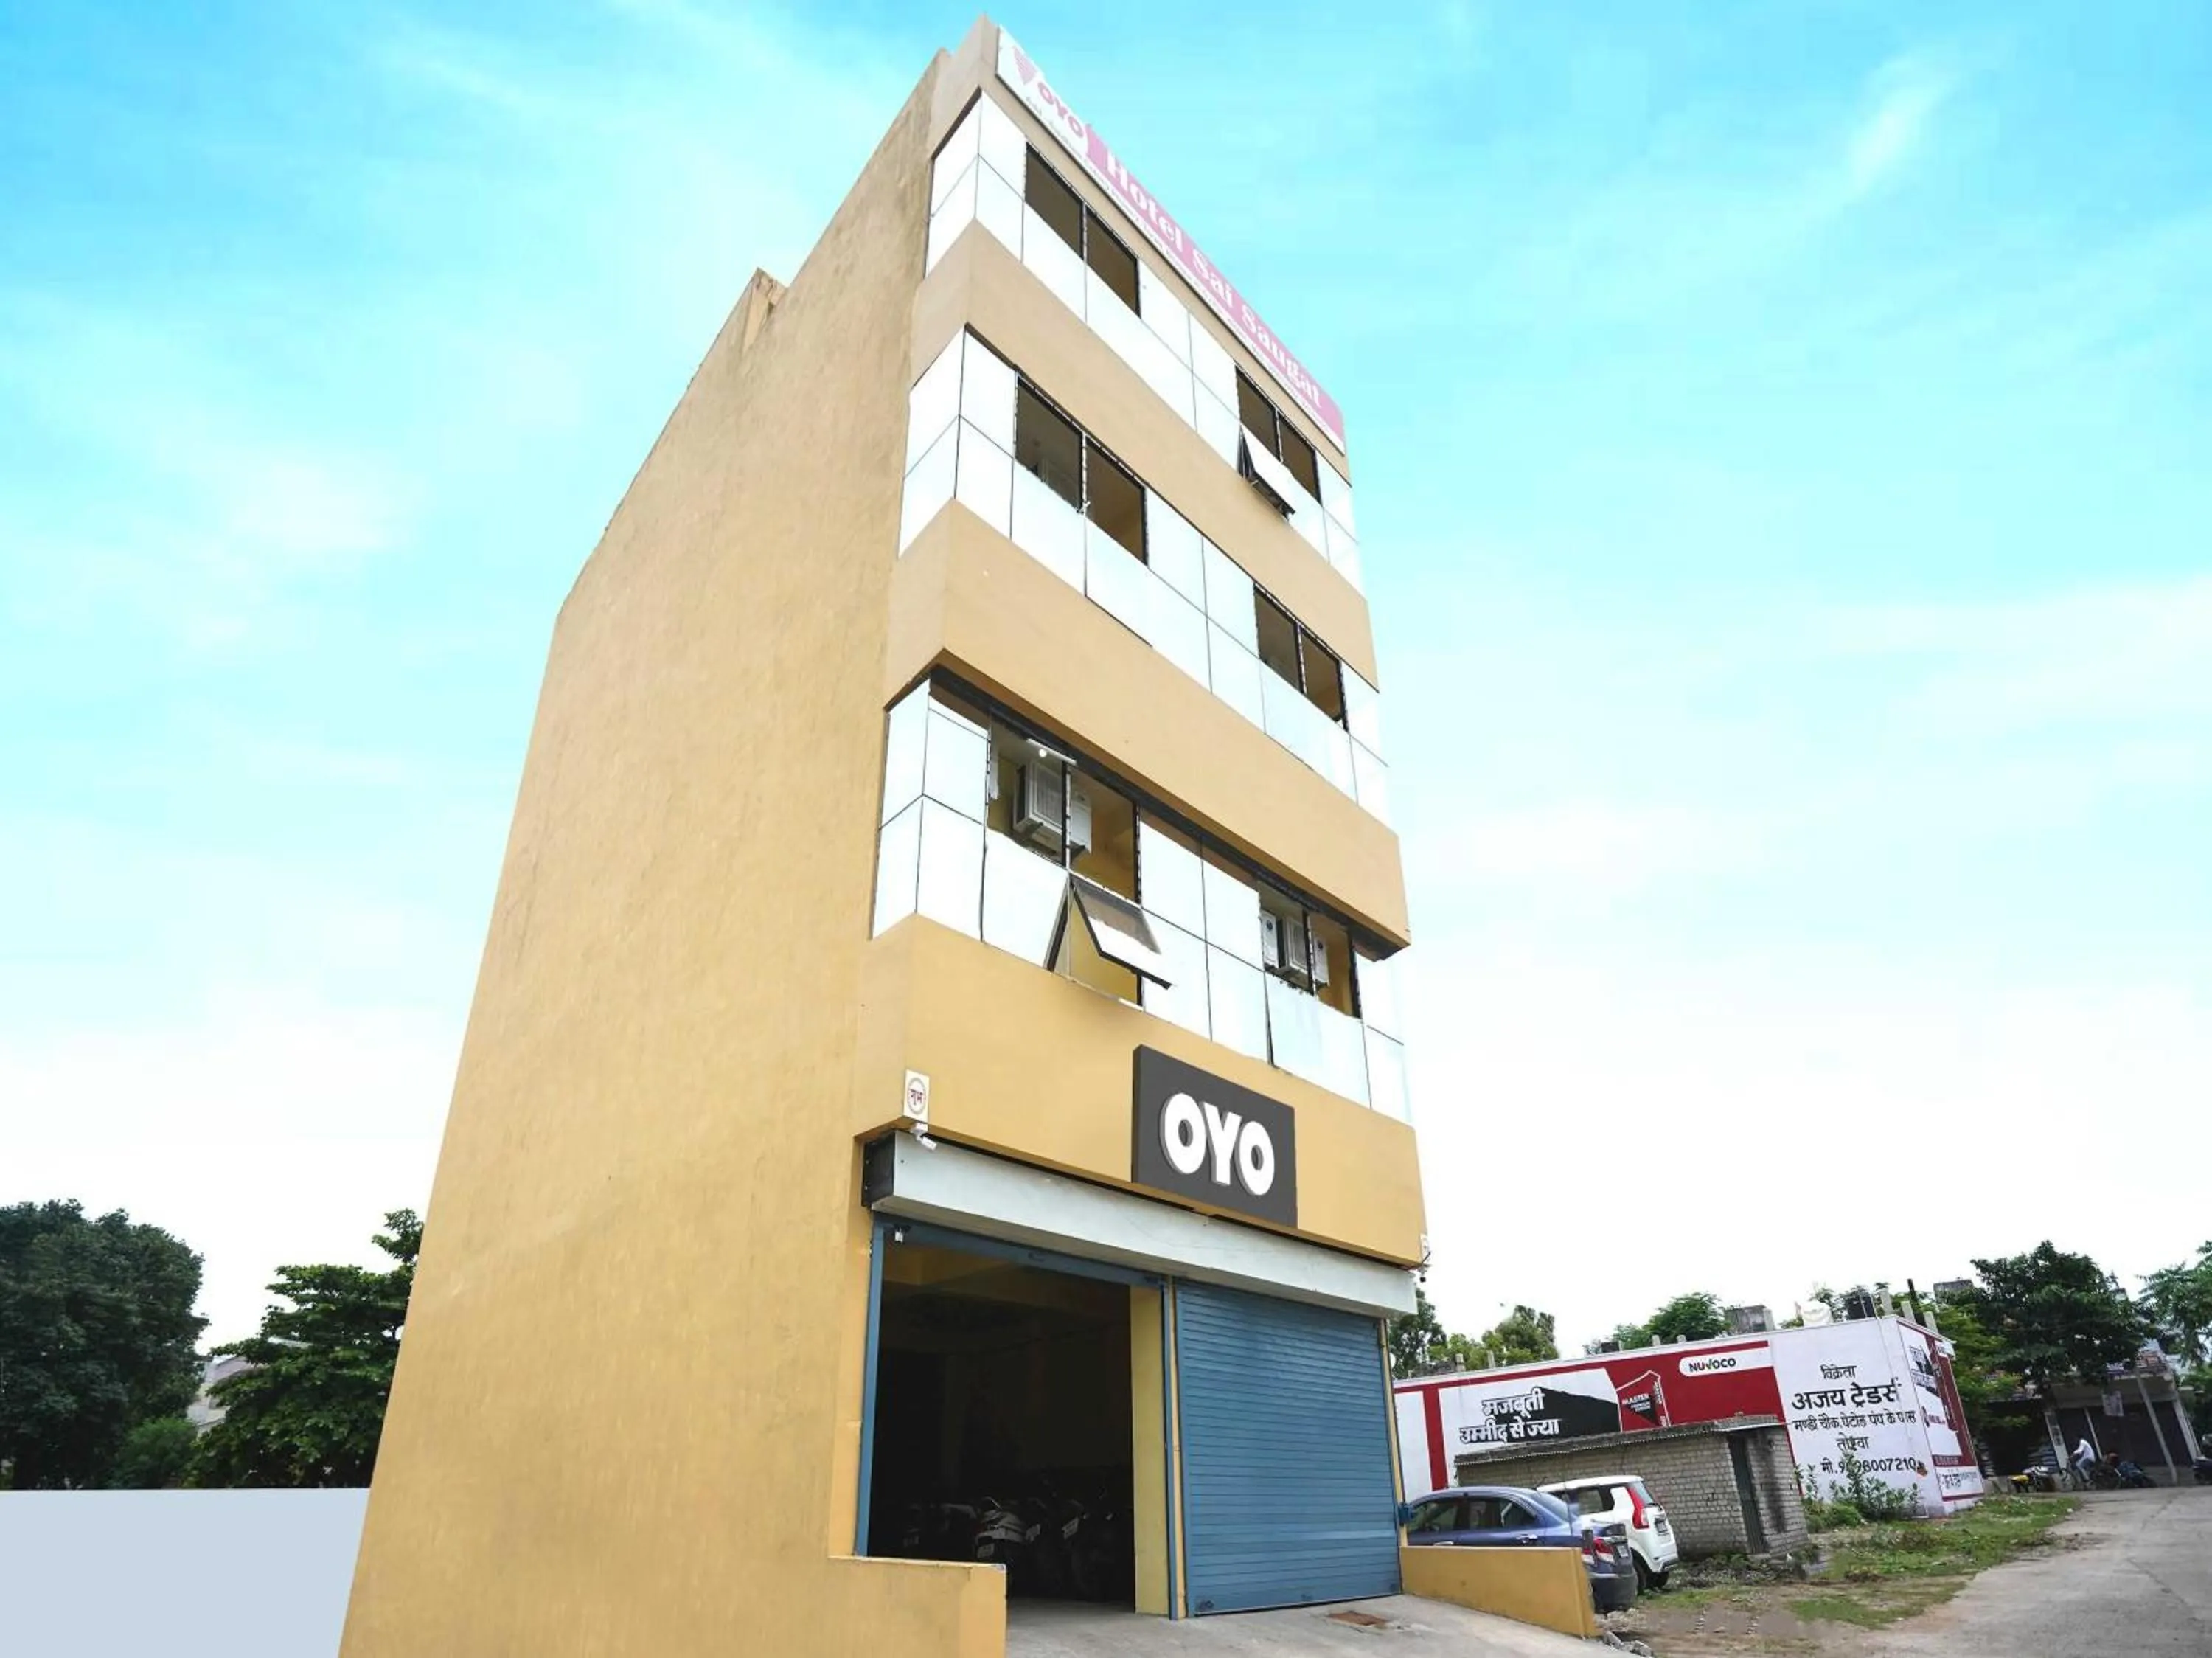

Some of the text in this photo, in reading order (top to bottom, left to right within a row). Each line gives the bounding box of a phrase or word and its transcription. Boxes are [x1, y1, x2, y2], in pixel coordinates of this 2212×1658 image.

[1037, 81, 1084, 139] OYO
[1107, 147, 1183, 252] Hotel
[1192, 248, 1234, 308] Sai
[1158, 1092, 1275, 1196] OYO
[1688, 1358, 1736, 1373] NUVOCO
[1820, 1364, 1857, 1380] विक्रेता
[1481, 1386, 1545, 1418] मजबूती
[1791, 1389, 1846, 1410] अजय
[1510, 1415, 1526, 1439] से
[1883, 1408, 1895, 1424] के
